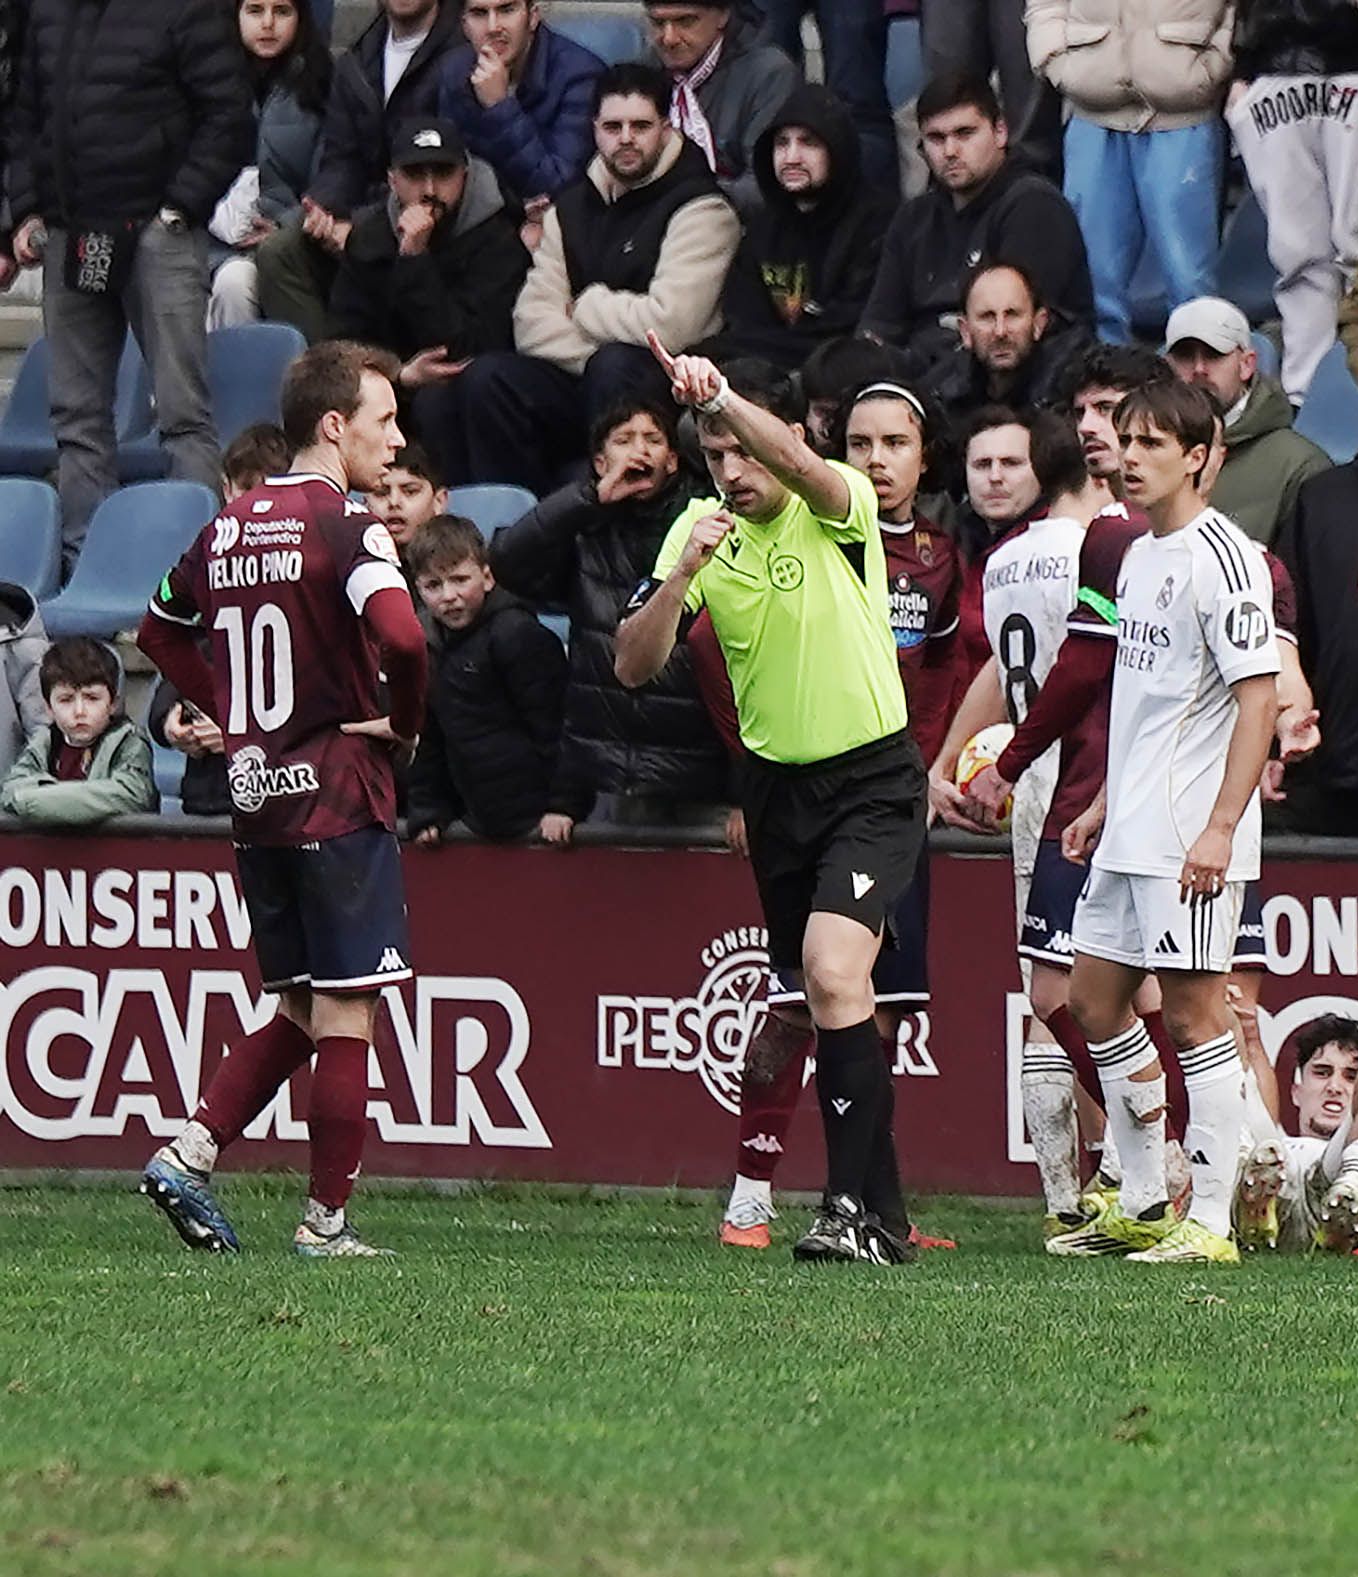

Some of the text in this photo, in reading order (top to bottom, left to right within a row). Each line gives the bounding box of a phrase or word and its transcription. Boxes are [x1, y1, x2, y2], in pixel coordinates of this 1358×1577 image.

[262, 550, 304, 585] PINO
[1232, 602, 1268, 650] hp
[213, 602, 295, 736] 10
[1000, 612, 1040, 728] 8
